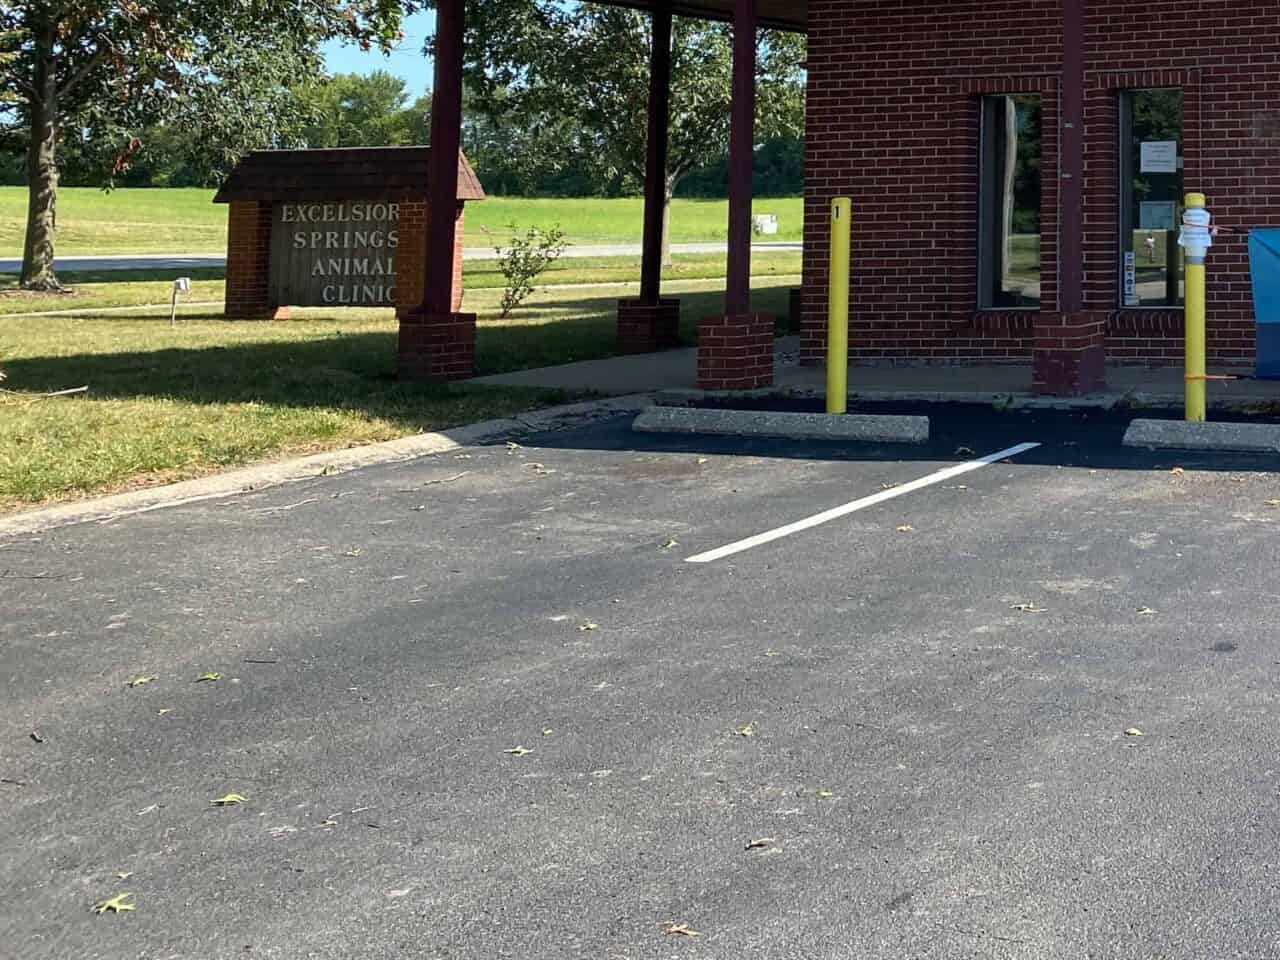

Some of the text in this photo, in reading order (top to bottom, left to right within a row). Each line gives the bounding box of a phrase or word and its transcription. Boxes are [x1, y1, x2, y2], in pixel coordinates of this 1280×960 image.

[281, 203, 400, 221] EXCELSIOR
[293, 230, 399, 248] SPRINGS
[312, 257, 397, 276] ANIMAL
[322, 284, 397, 303] CLINIC
